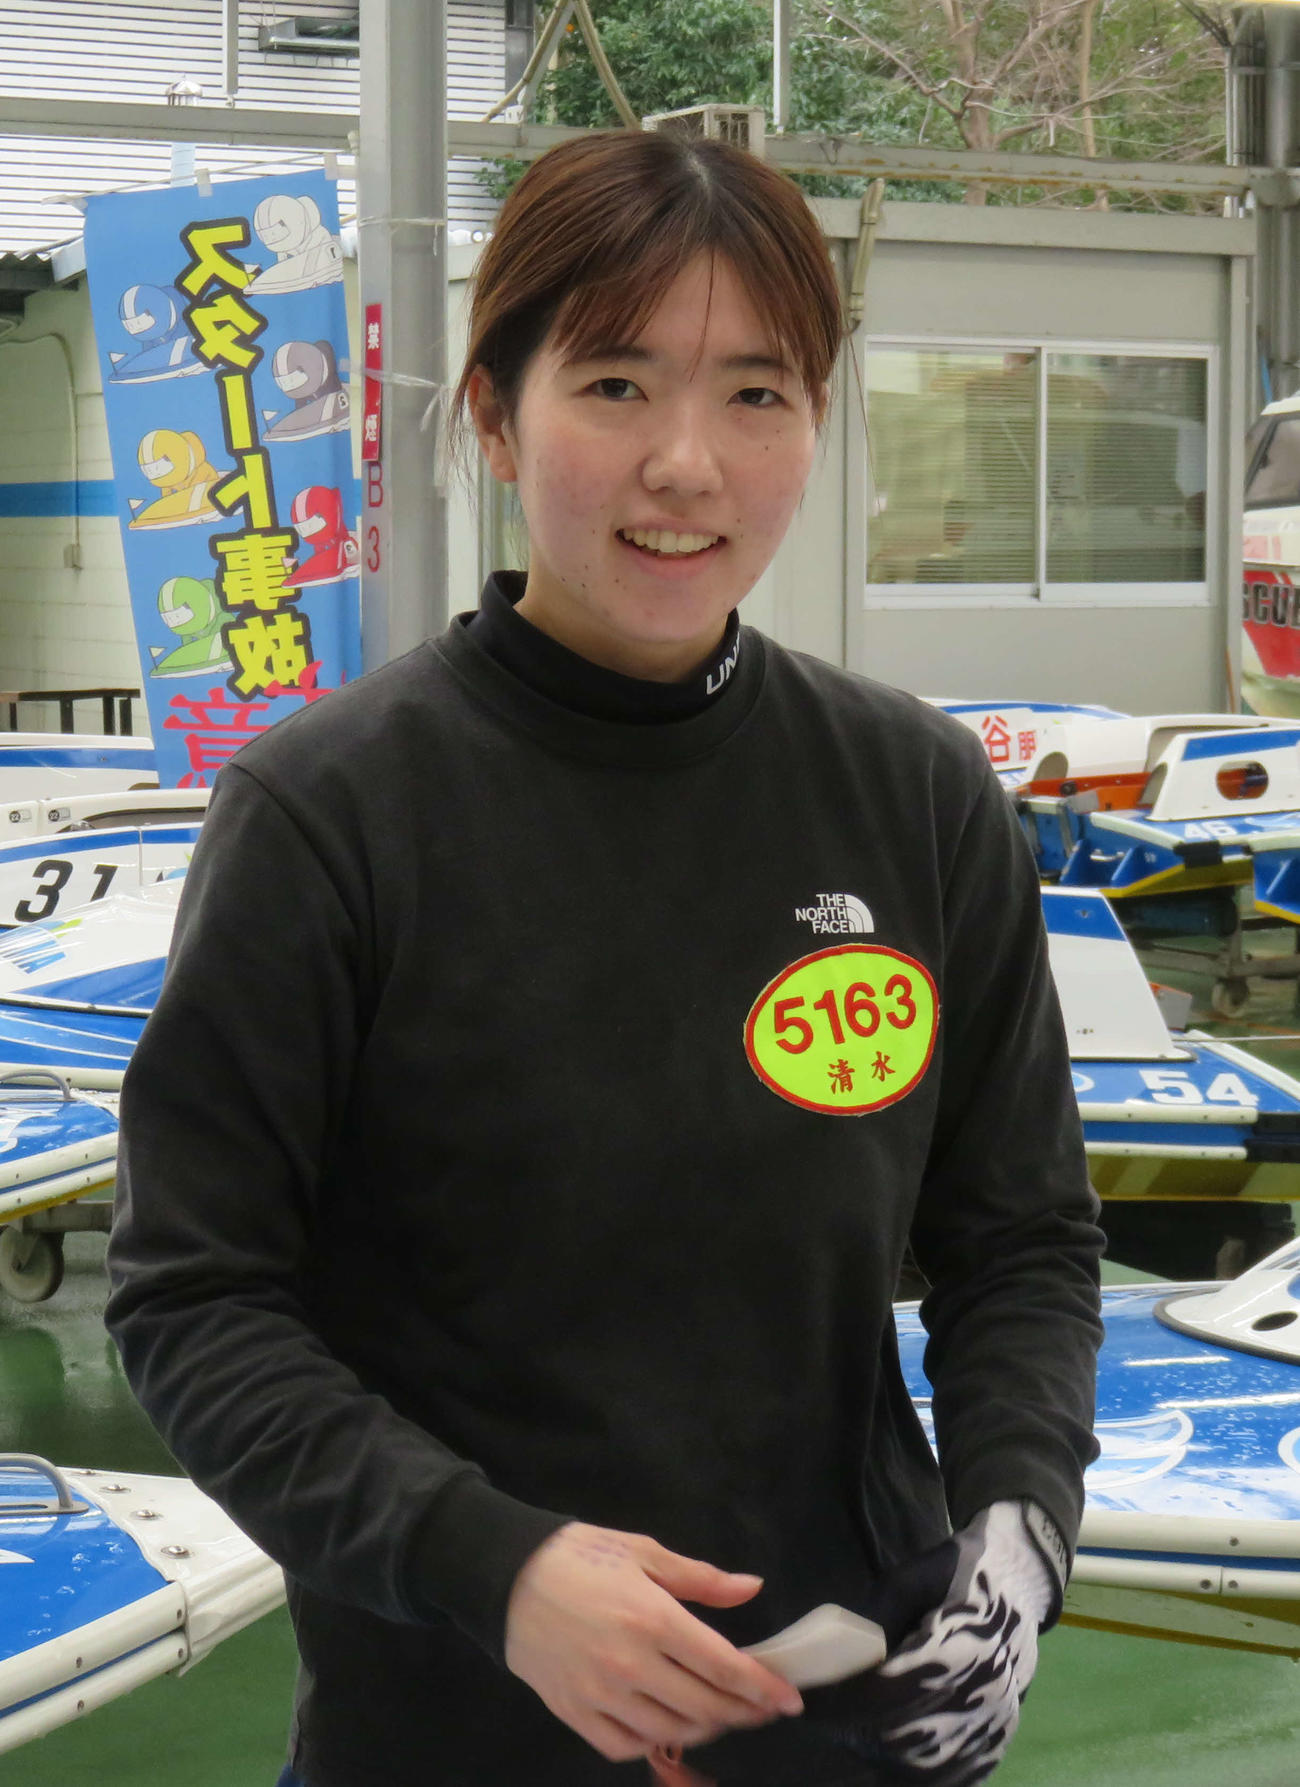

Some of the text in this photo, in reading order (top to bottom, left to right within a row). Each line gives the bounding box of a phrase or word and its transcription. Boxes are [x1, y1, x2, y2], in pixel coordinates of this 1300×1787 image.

[816, 893, 846, 907] THE
[795, 906, 848, 921] NORTH
[812, 920, 850, 934] FACE
[774, 974, 917, 1054] 5163
[1138, 1069, 1260, 1107] 54
